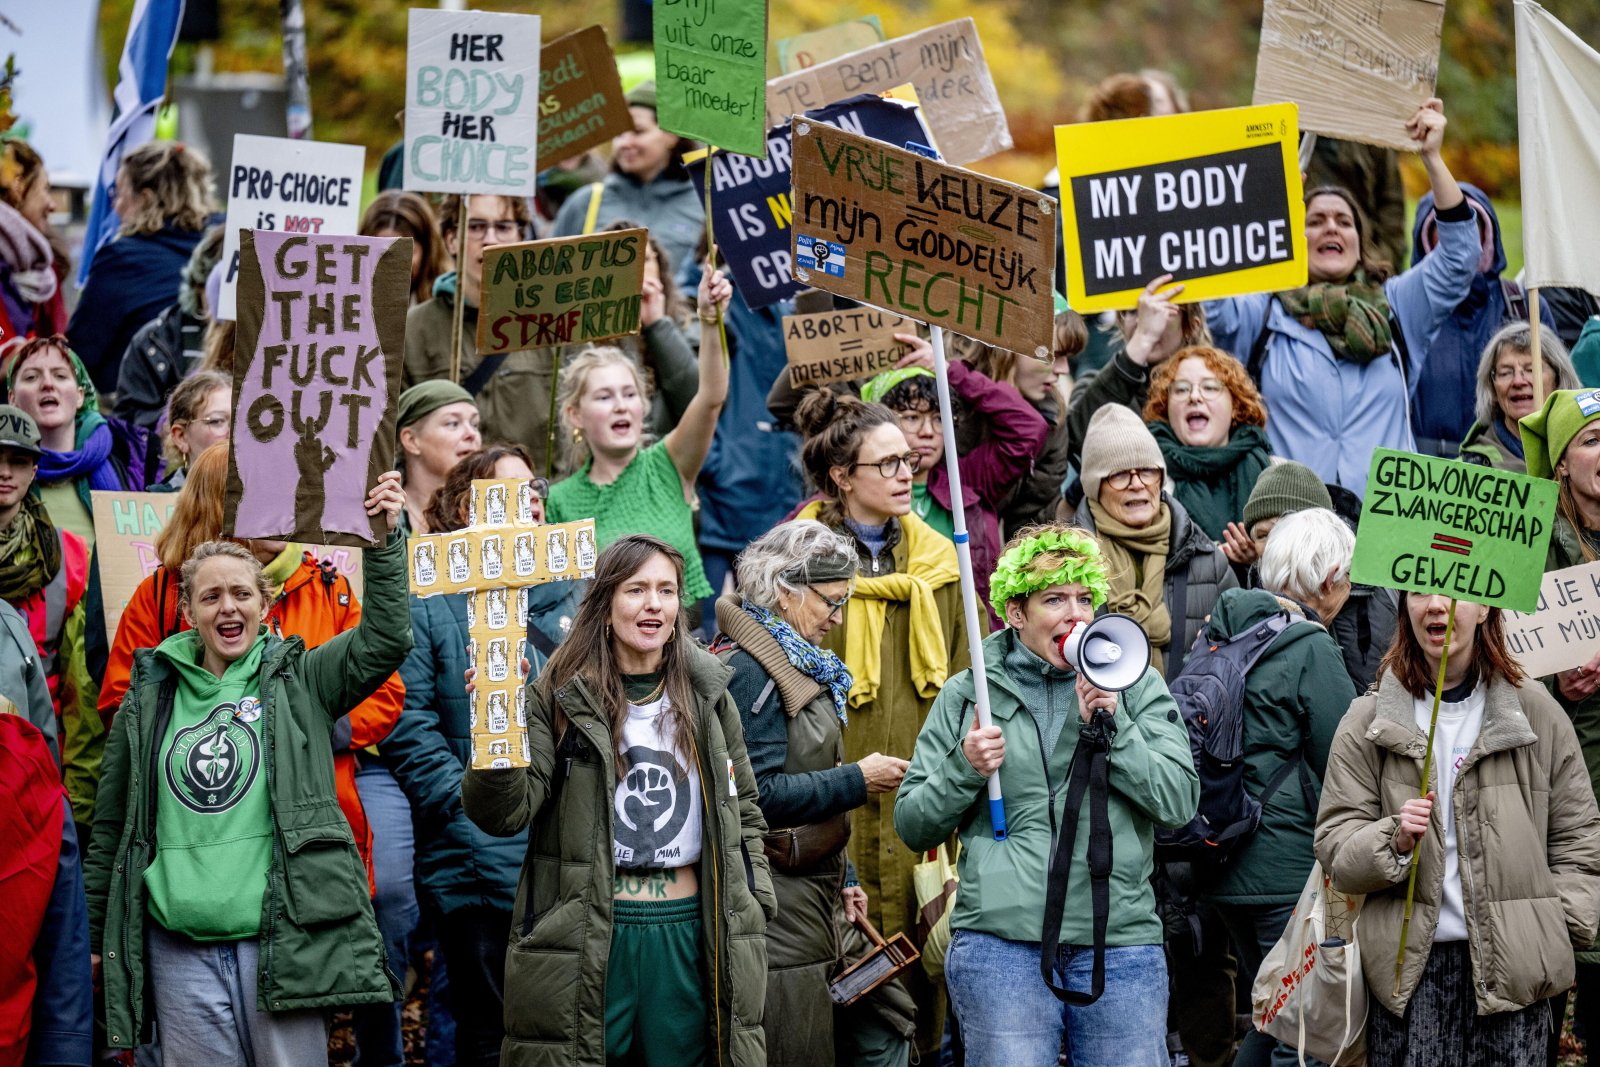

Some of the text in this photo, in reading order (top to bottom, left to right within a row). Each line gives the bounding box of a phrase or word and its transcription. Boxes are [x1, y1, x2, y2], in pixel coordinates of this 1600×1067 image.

[450, 33, 503, 62] HER
[665, 17, 757, 58] uit onze
[416, 66, 524, 116] BODY
[666, 50, 716, 85] baar
[441, 112, 496, 142] HER
[411, 135, 529, 187] CHOICE
[1089, 163, 1248, 219] MY BODY
[284, 215, 324, 234] NOT
[727, 203, 767, 242] IS
[274, 236, 370, 285] GET
[492, 236, 638, 285] ABORTUS
[1093, 218, 1288, 279] MY CHOICE
[555, 273, 614, 304] EEN
[864, 250, 1020, 337] RECHT
[272, 290, 361, 341] THE
[261, 342, 380, 390] FUCK
[247, 389, 372, 449] OUT
[1376, 455, 1531, 510] GEDWONGEN
[112, 500, 174, 535] HA
[1369, 490, 1543, 548] ZWANGERSCHAP
[1391, 553, 1506, 599] GEWELD
[656, 846, 680, 858] MINA
